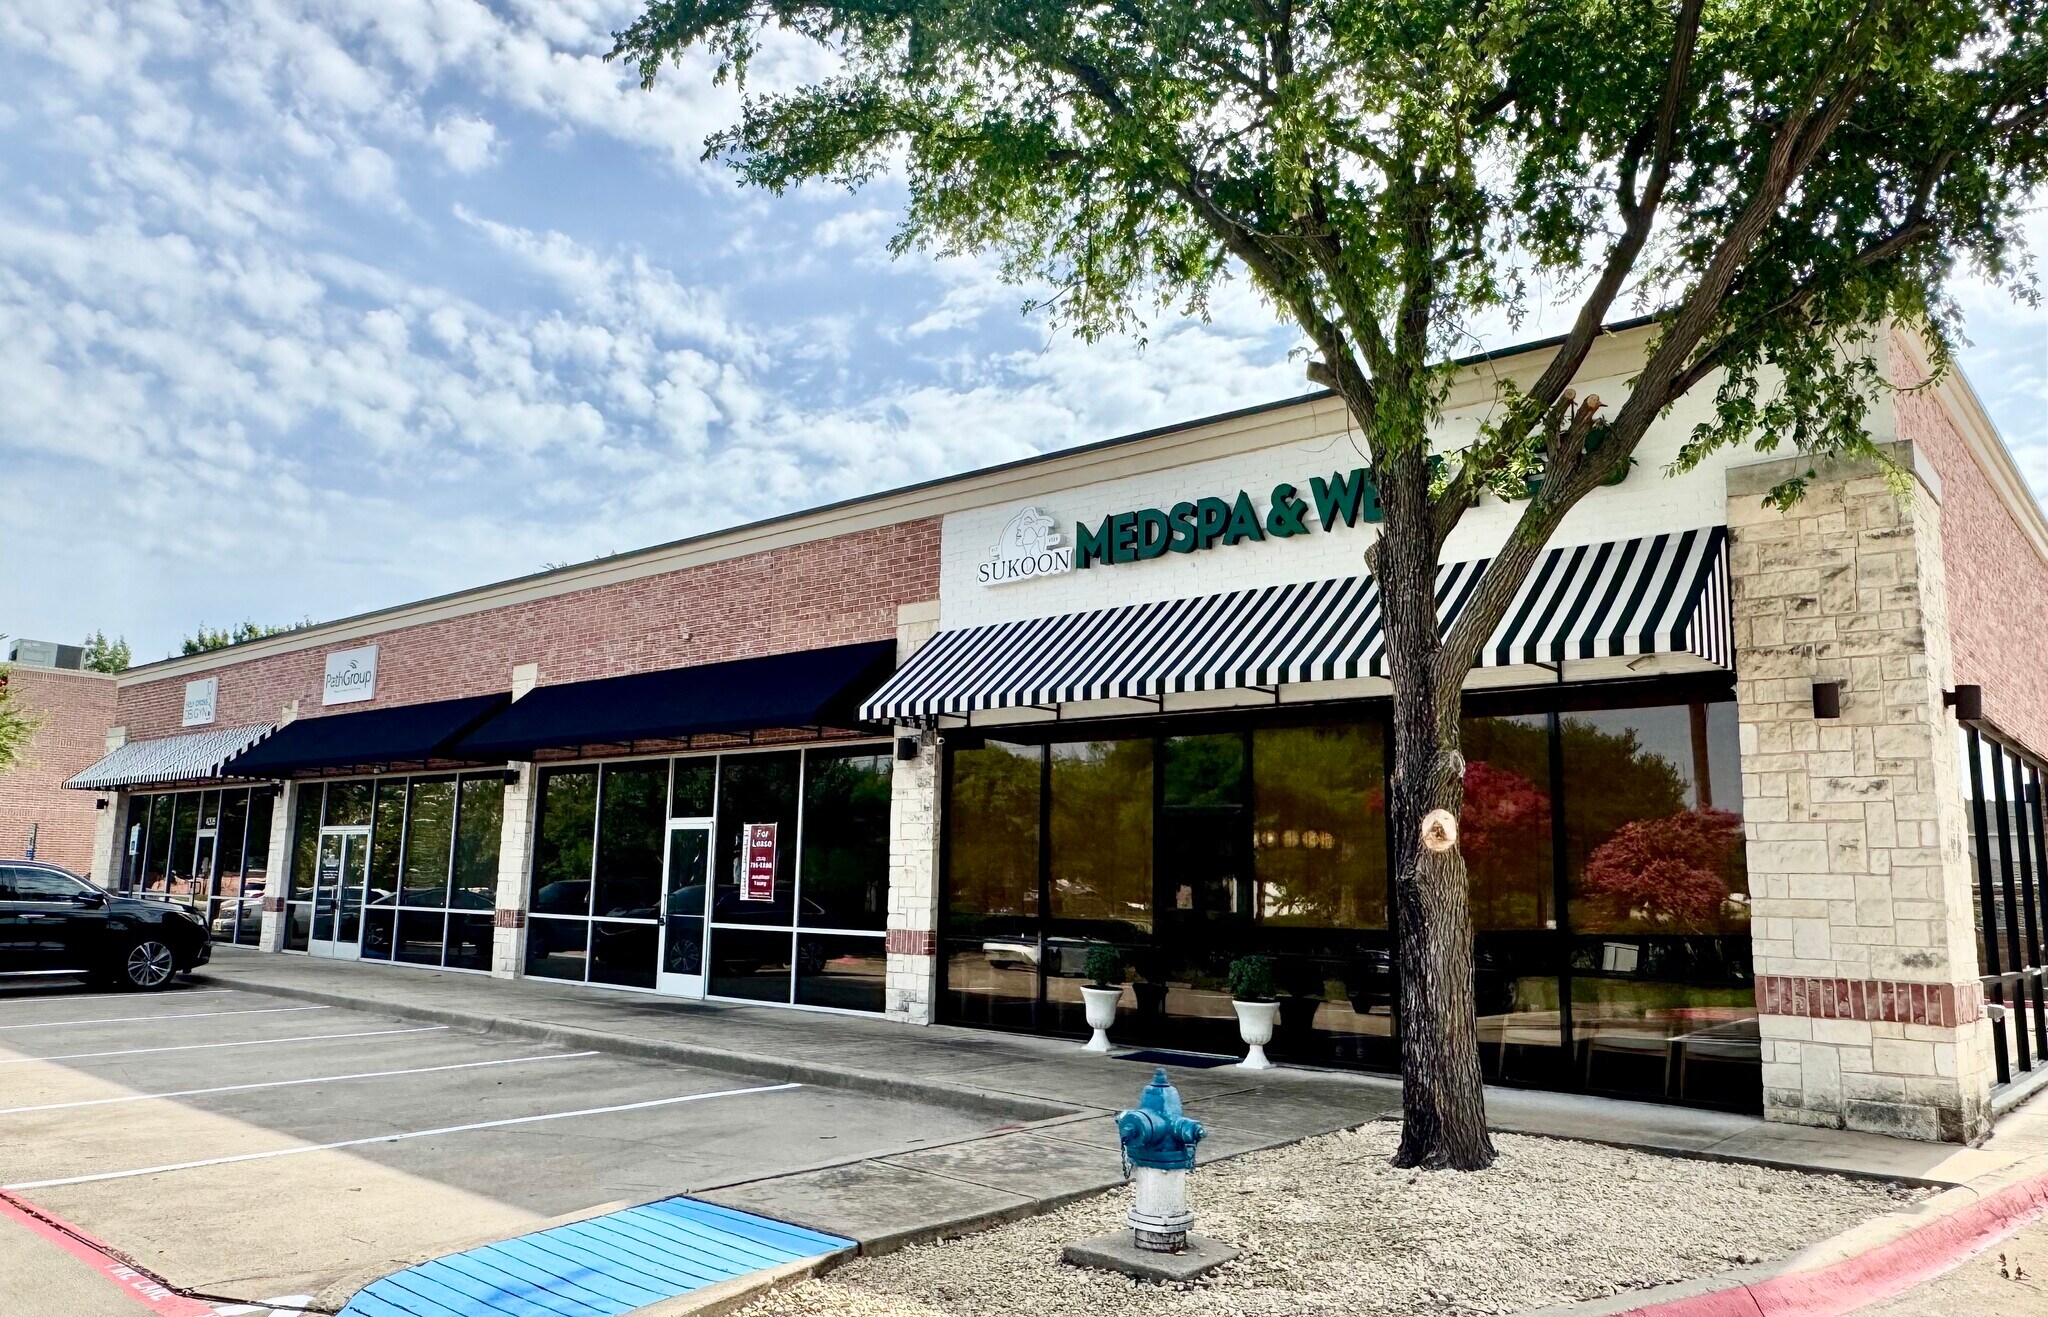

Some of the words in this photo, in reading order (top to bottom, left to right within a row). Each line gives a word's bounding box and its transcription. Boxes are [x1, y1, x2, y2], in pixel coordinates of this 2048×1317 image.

[1076, 490, 1266, 569] MEDSPA
[1266, 483, 1311, 538] &
[979, 549, 1070, 582] SUKOON
[752, 840, 773, 848] Lease
[756, 830, 769, 838] For
